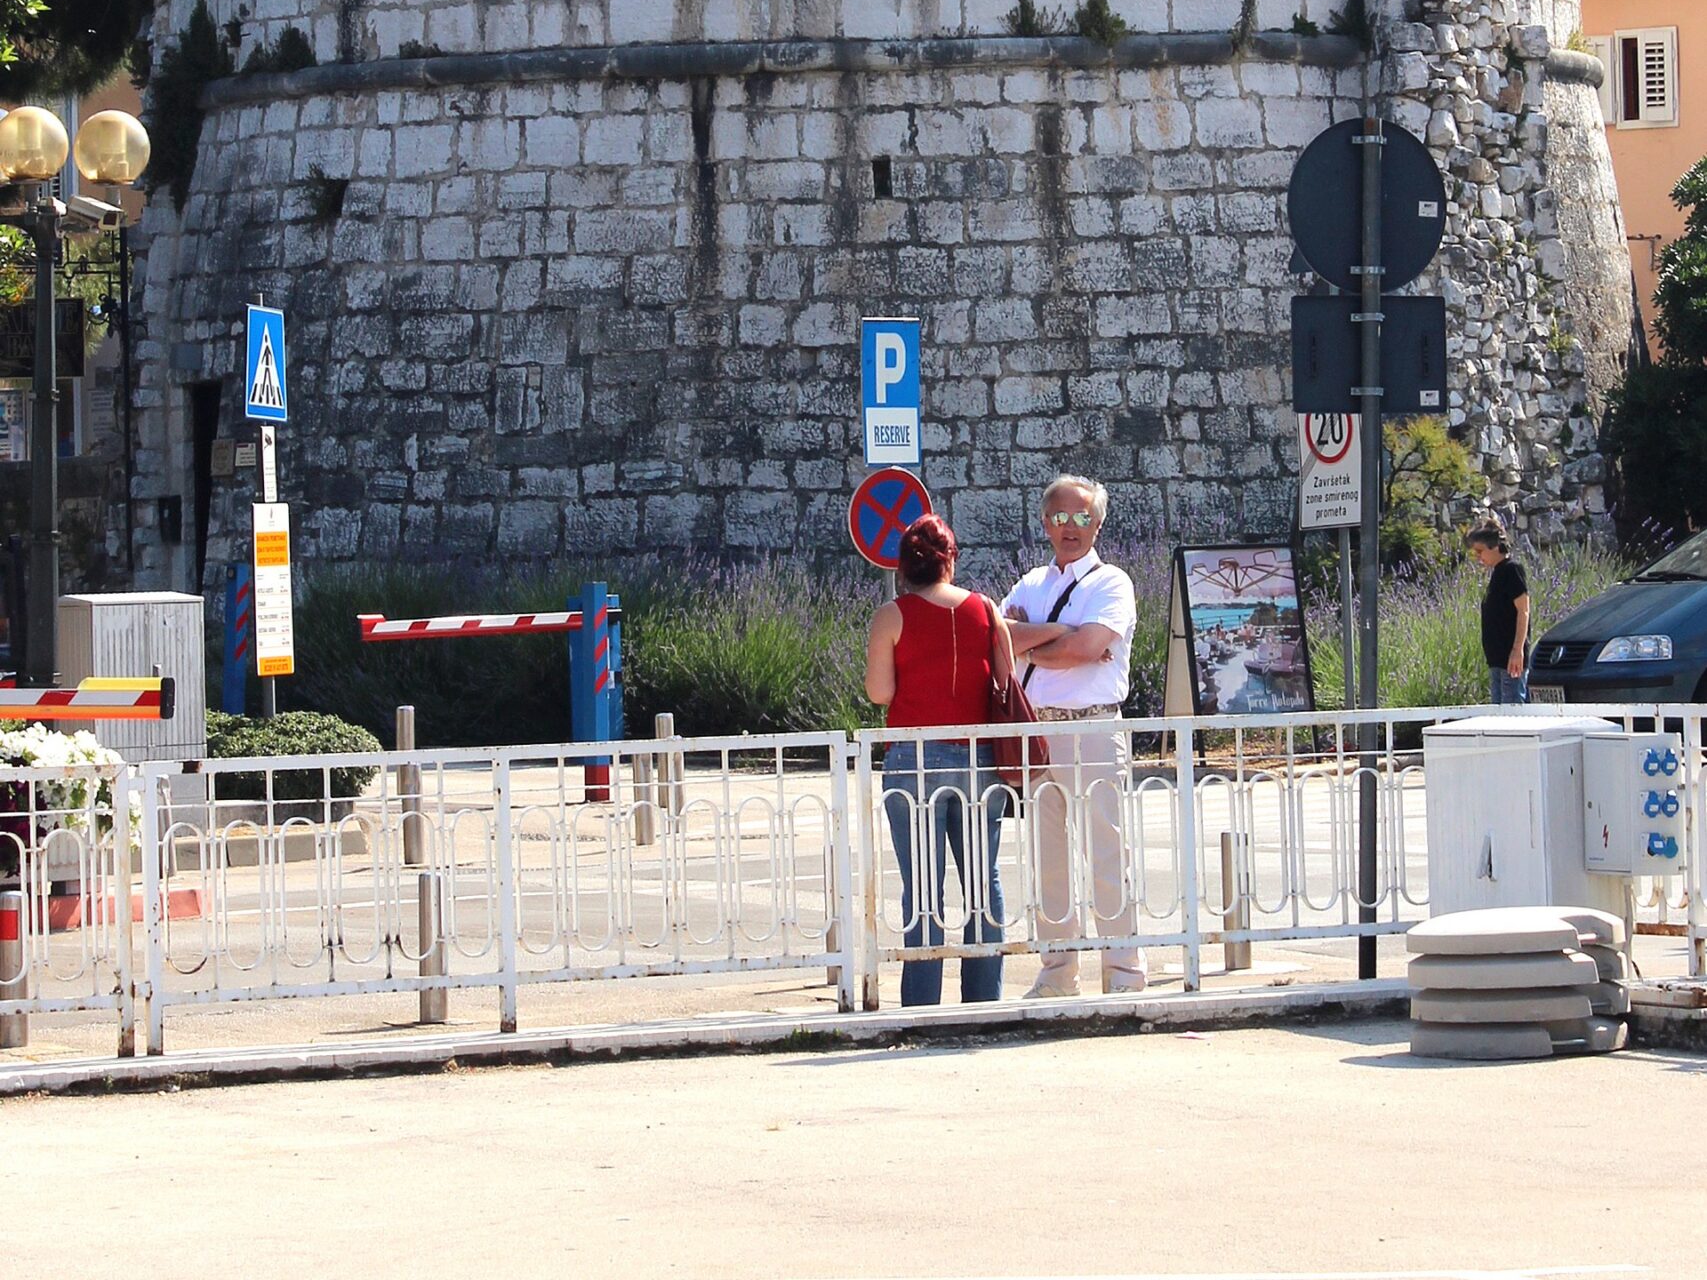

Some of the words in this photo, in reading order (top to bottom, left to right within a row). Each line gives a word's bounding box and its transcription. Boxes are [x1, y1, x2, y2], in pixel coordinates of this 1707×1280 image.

[875, 332, 906, 404] P
[874, 425, 911, 444] RESERVE
[1315, 412, 1344, 445] 20
[1313, 473, 1351, 488] Završetak
[1306, 494, 1323, 505] zone
[1324, 490, 1359, 503] smirenog
[1315, 506, 1347, 520] prometa
